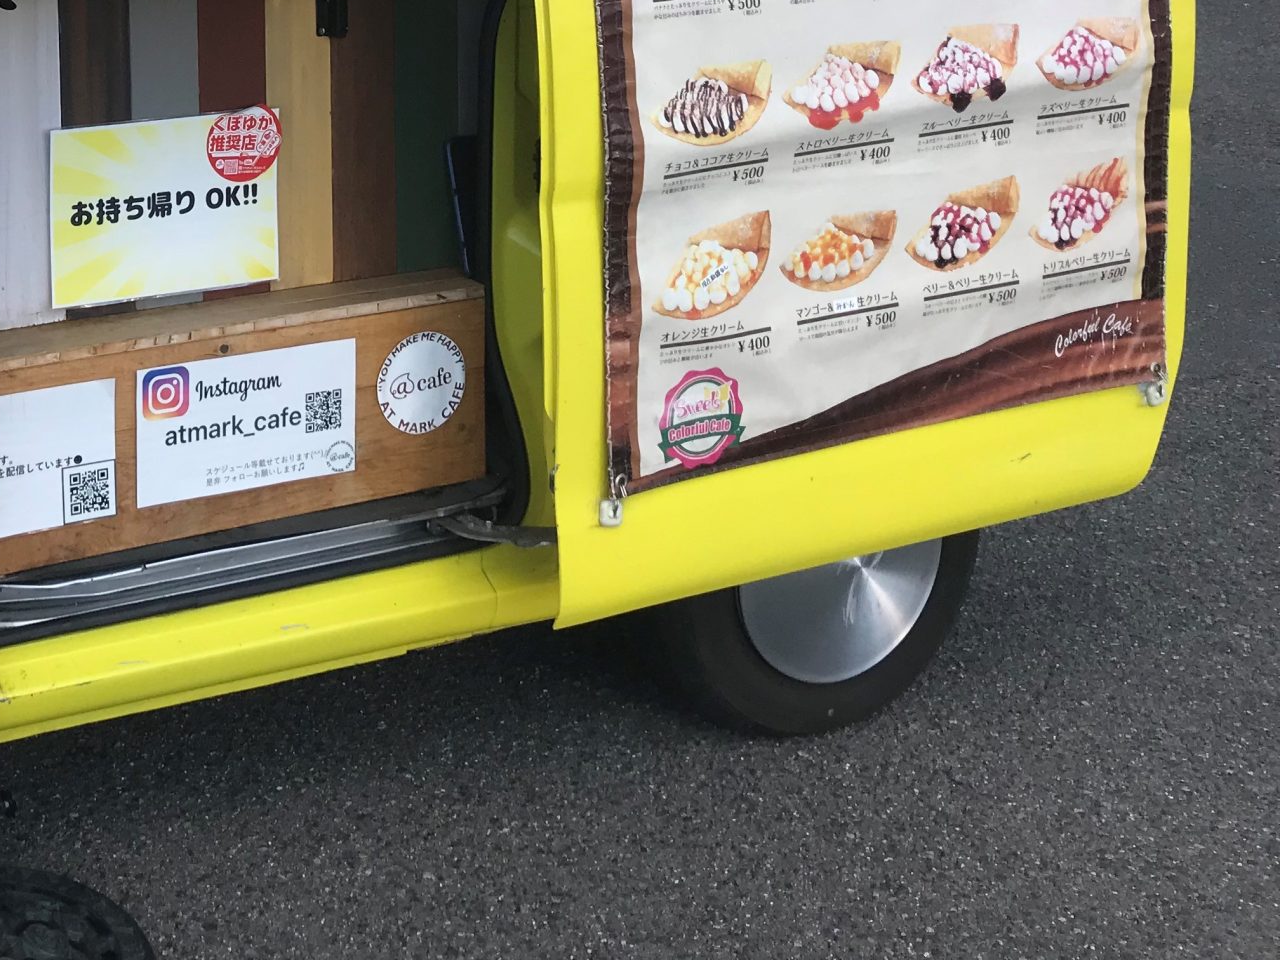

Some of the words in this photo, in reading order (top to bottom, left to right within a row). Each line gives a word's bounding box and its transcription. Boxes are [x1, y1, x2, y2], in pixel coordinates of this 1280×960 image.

[213, 115, 273, 132] くぼゆか
[1098, 110, 1127, 125] ¥400
[209, 134, 258, 152] 推奨店
[980, 127, 1011, 142] ¥400
[860, 145, 891, 161] ¥400
[732, 166, 765, 182] ¥500
[70, 189, 196, 227] お持ち帰り
[205, 183, 259, 210] OK!!
[987, 288, 1017, 304] ¥500
[865, 310, 897, 328] ¥500
[660, 320, 745, 343] オレンジ生クリーム
[391, 334, 419, 358] MAKE
[421, 332, 437, 342] ME
[737, 335, 771, 353] ¥400
[195, 373, 283, 403] Instagram
[380, 401, 396, 420] AT
[397, 418, 438, 434] MARK
[441, 381, 465, 419] CAFE
[164, 405, 302, 447] atmark_cafe
